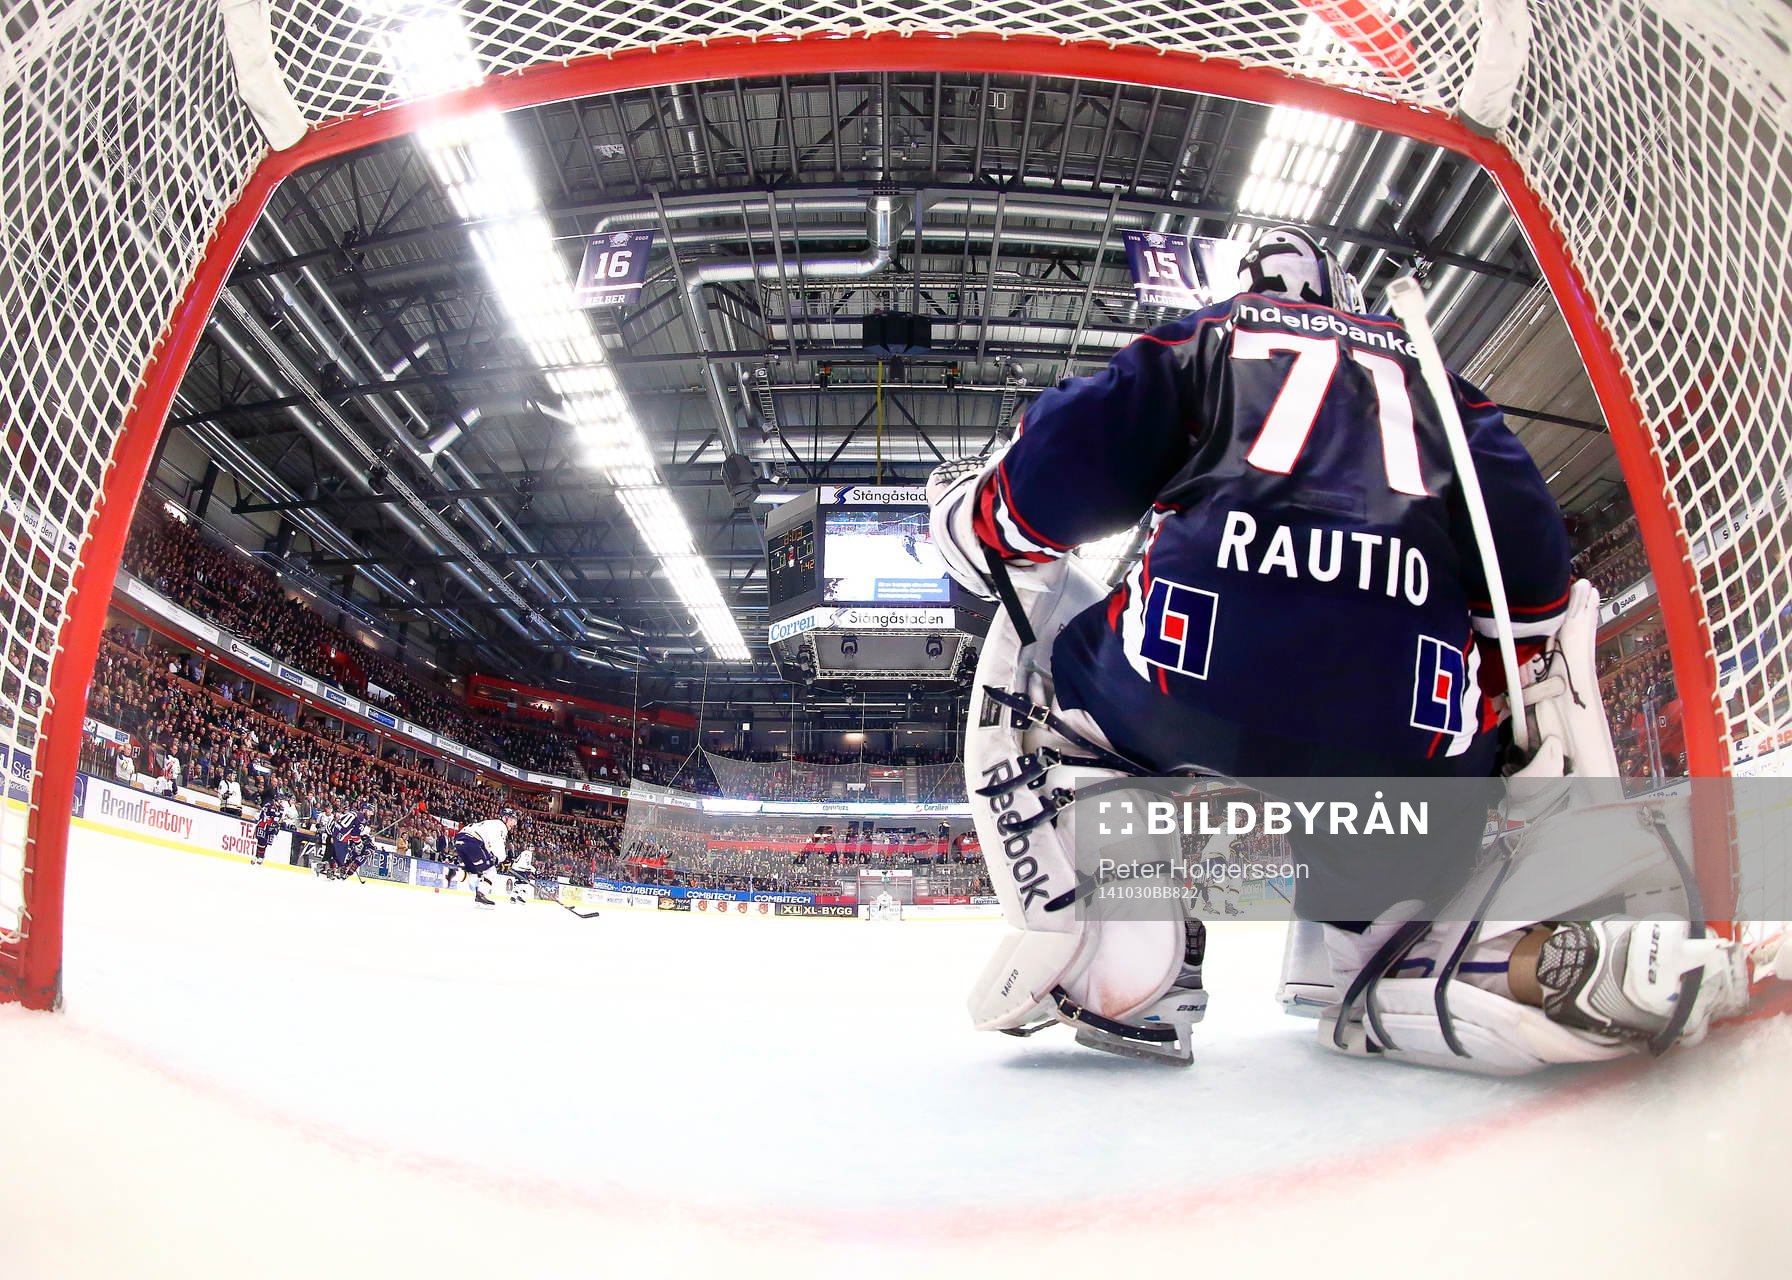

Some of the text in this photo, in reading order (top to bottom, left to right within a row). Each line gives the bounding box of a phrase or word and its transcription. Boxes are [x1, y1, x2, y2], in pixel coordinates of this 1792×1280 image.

[594, 250, 632, 280] 16
[1143, 250, 1181, 280] 15
[1214, 303, 1419, 359] ndelsbanke
[1230, 327, 1433, 497] 71
[853, 488, 927, 504] Stångåstad
[1216, 510, 1430, 607] RAUTIO
[1620, 593, 1636, 608] SAAB
[770, 613, 816, 642] Corren
[849, 610, 944, 628] Stångåstaden
[13, 760, 31, 781] Sta
[101, 788, 193, 840] BrandFactory
[982, 758, 1050, 912] Reebok
[621, 884, 671, 897] COMBITECH
[686, 890, 737, 901] COMBITECH
[754, 894, 811, 904] COMBITECH
[803, 905, 853, 916] XL-BYGG
[1001, 968, 1019, 997] RAUTIO
[1176, 1004, 1206, 1012] BAU
